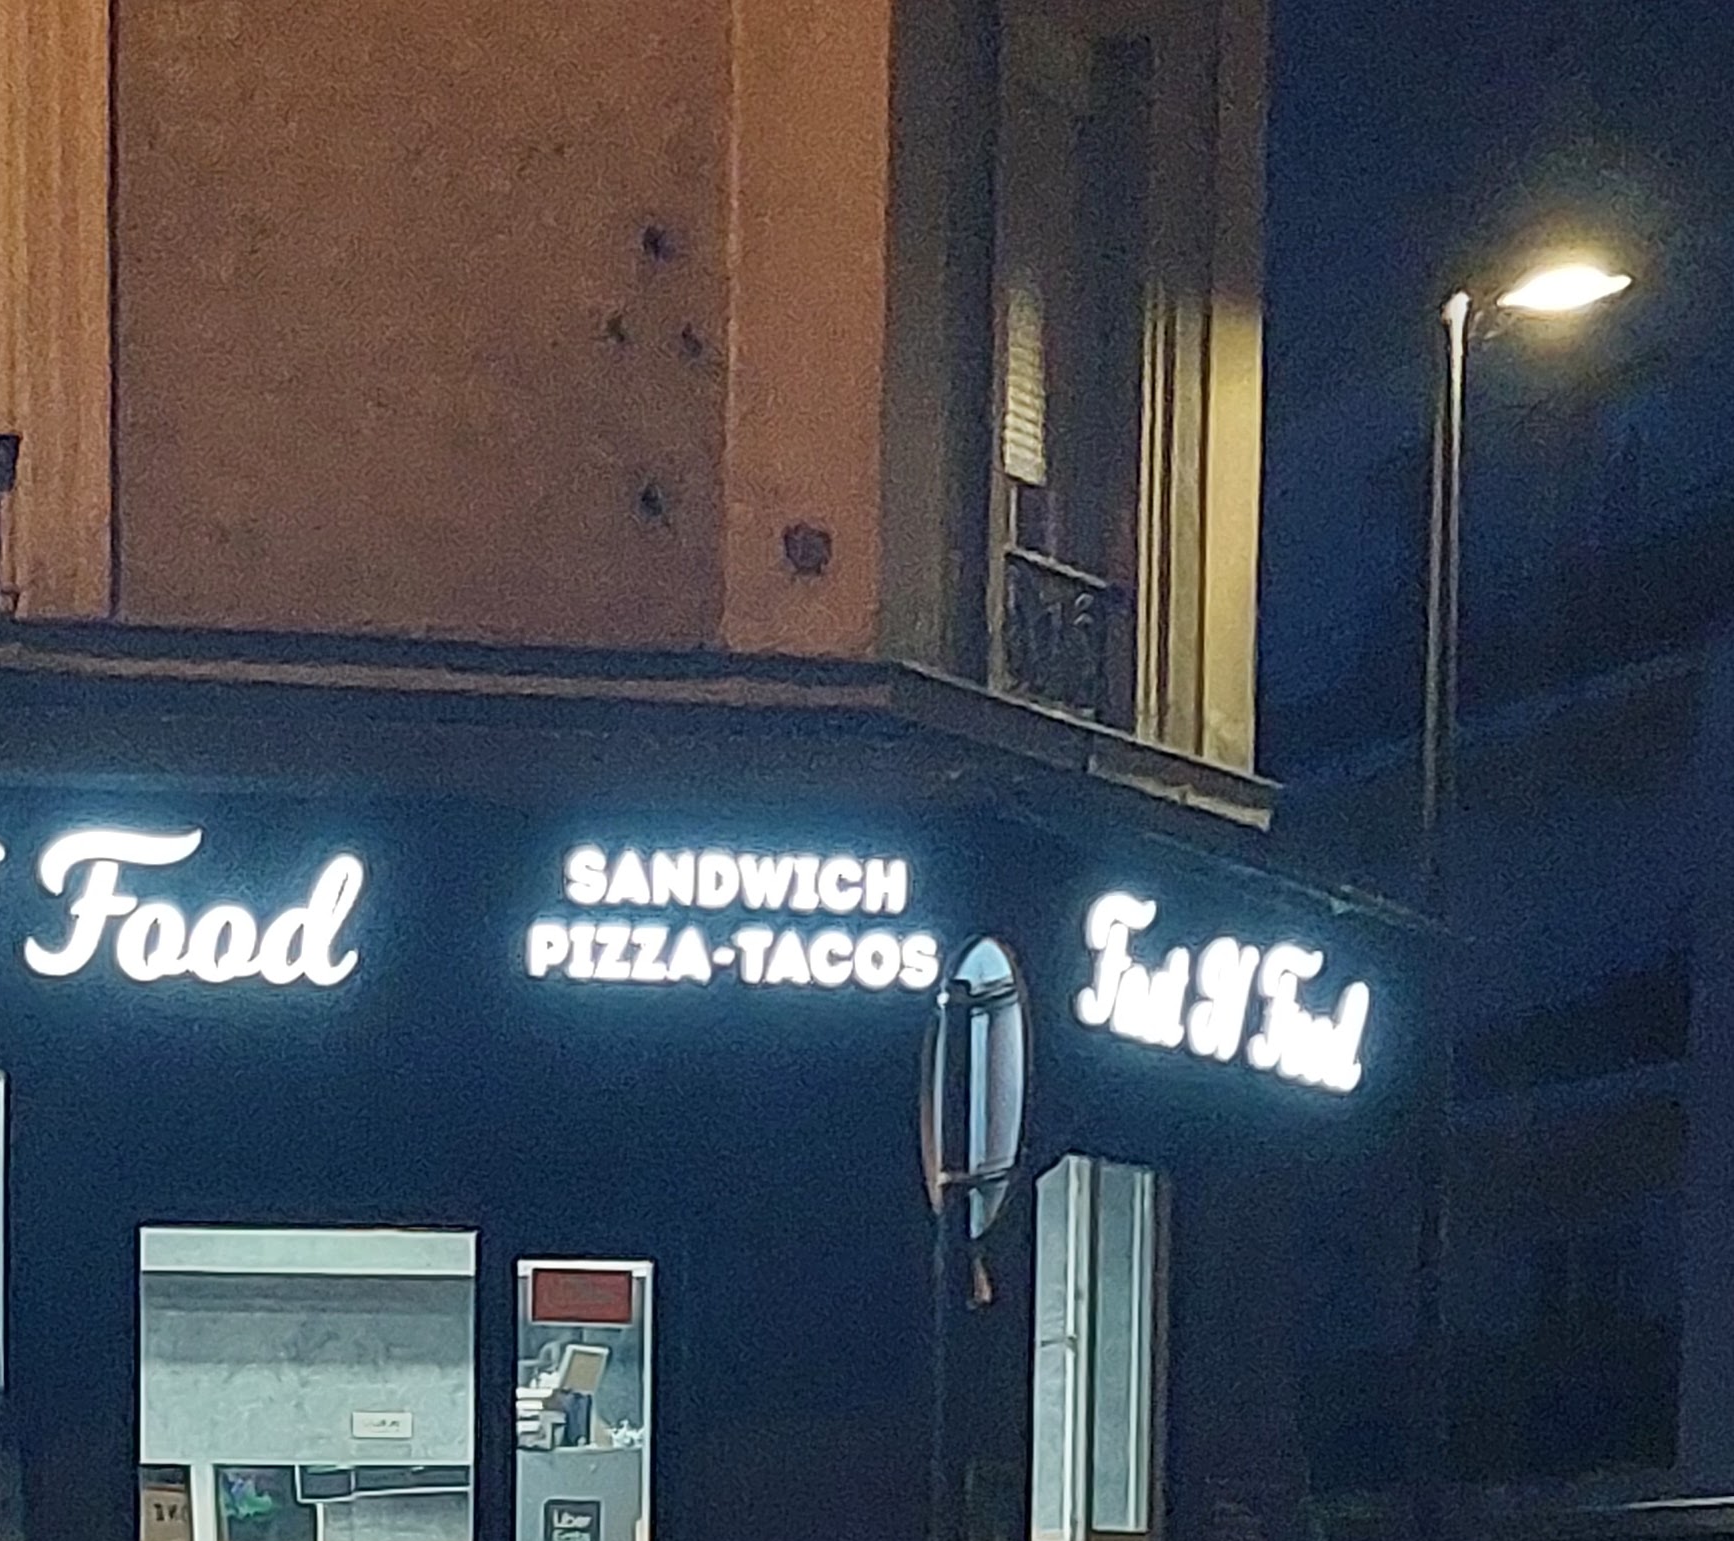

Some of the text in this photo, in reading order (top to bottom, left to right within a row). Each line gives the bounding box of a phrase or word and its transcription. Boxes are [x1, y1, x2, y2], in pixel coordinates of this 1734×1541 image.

[24, 826, 364, 986] Food
[564, 844, 908, 913] SANDWICH
[526, 919, 940, 989] PIZZA-TACOS
